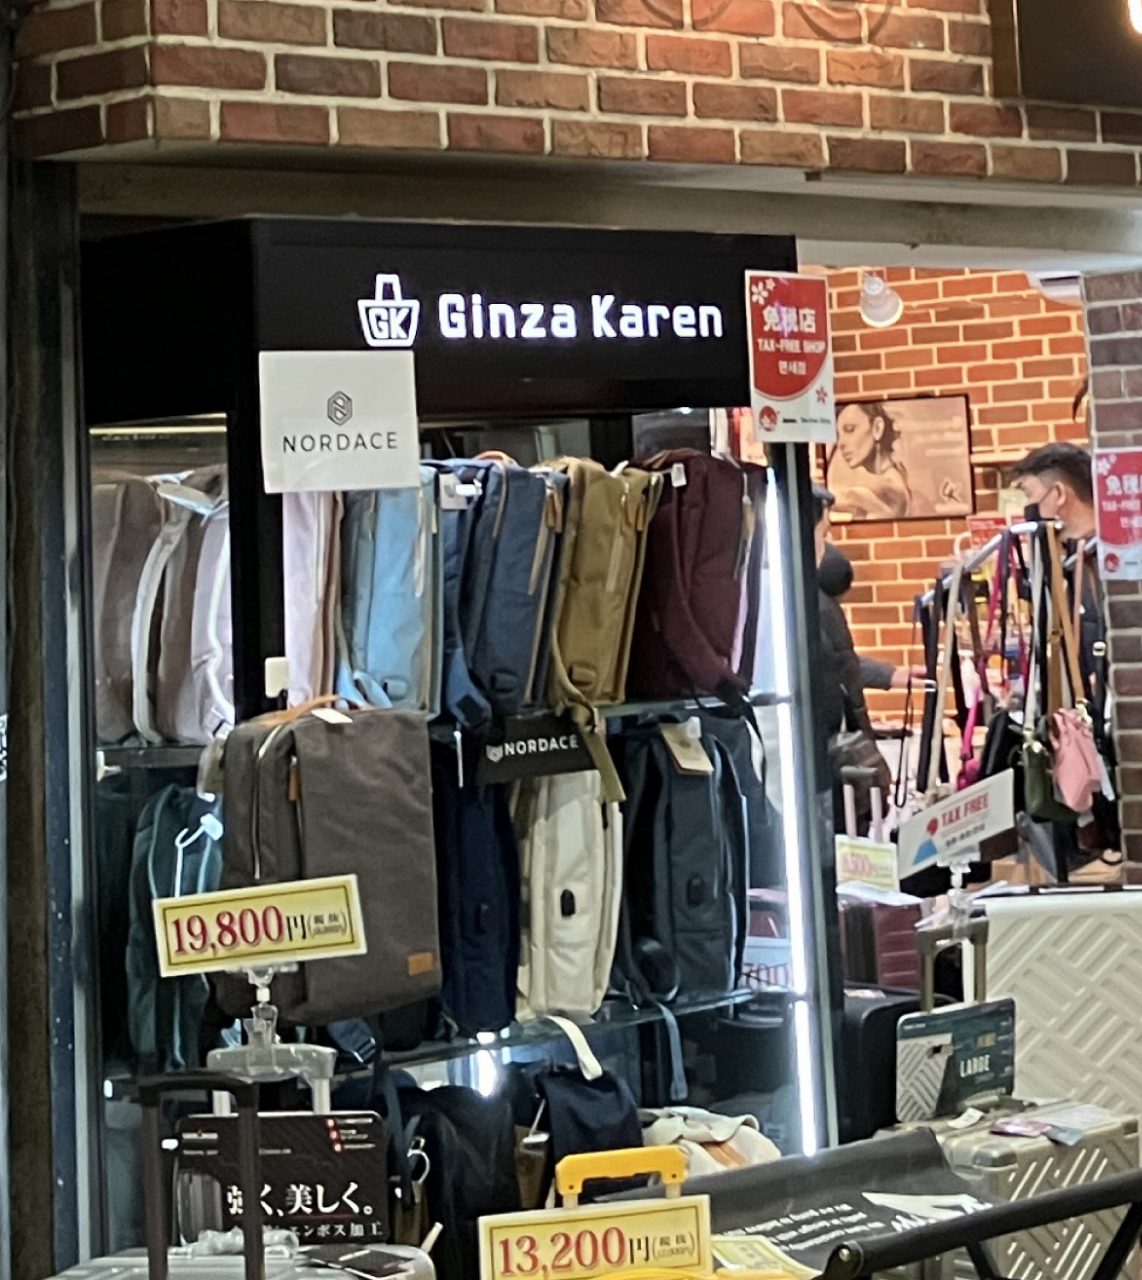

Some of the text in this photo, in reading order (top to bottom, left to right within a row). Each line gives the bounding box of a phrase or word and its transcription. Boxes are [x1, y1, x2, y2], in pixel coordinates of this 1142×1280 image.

[367, 293, 723, 340] GK Ginza Karen
[283, 431, 398, 453] NORDACE
[504, 733, 578, 756] NORDACE
[941, 807, 961, 827] TAX
